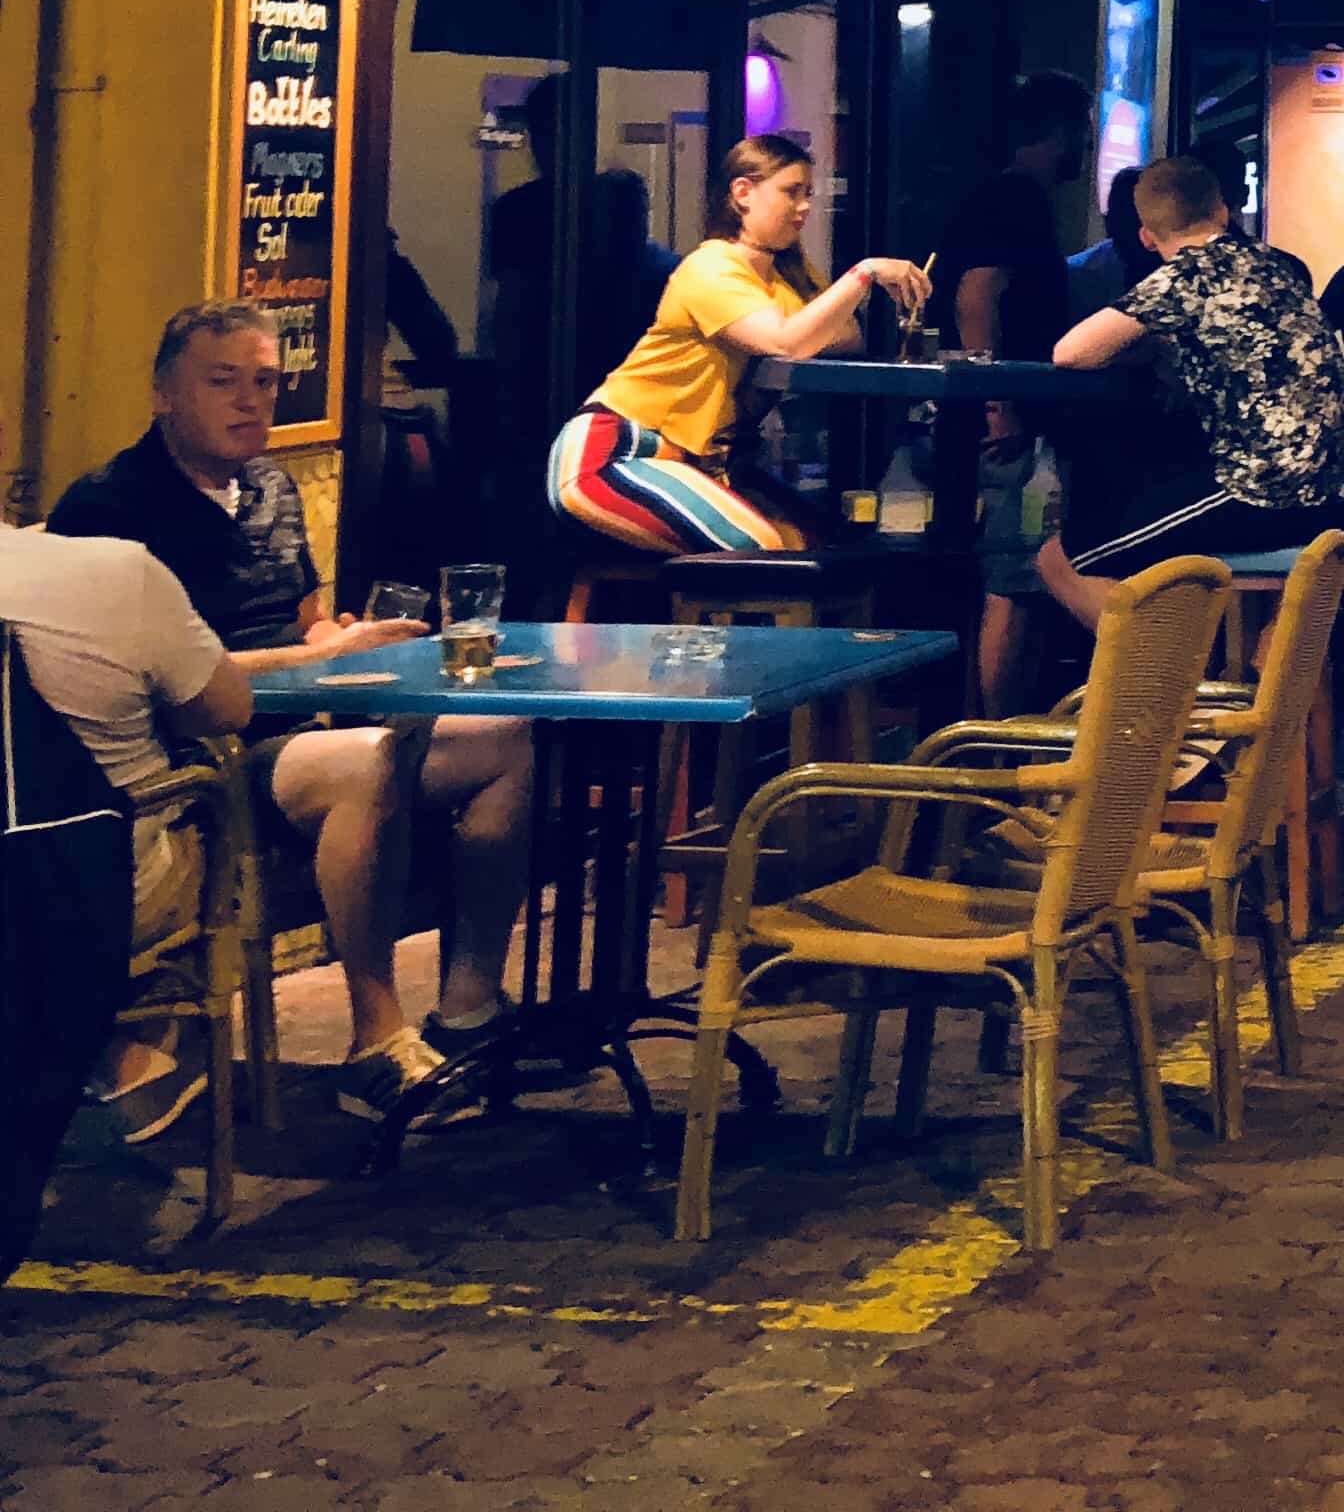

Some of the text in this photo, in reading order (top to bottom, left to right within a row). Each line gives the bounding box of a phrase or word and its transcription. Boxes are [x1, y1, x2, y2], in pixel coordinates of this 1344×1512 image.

[257, 29, 319, 73] Carling
[247, 76, 331, 128] Bottles
[245, 180, 324, 219] Fruit cider
[255, 222, 289, 262] Sol
